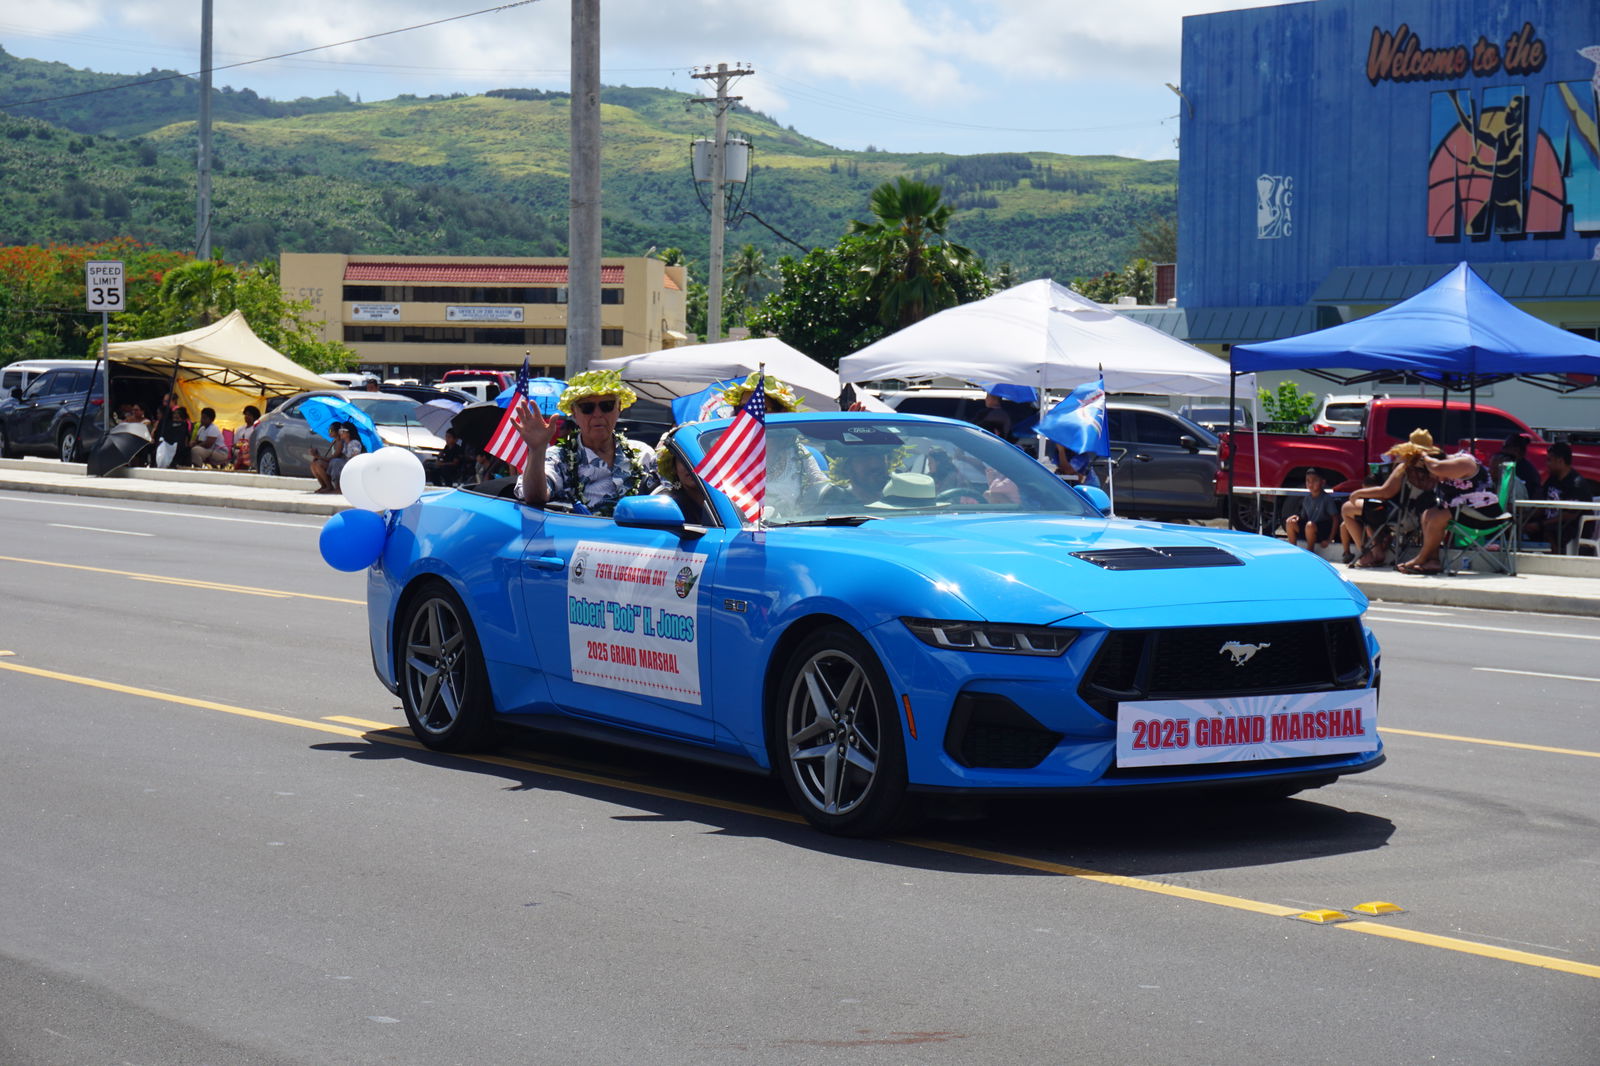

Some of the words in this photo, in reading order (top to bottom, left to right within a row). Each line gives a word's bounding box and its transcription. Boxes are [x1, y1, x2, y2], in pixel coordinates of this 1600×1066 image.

[1367, 23, 1469, 87] Welcome
[1472, 35, 1500, 78] to
[1504, 21, 1546, 75] the
[89, 267, 121, 275] SPEED
[93, 277, 117, 285] LIMIT
[92, 287, 120, 305] 35
[613, 565, 653, 585] LIBERATION
[653, 569, 667, 586] DAY
[569, 596, 605, 628] Robert
[643, 606, 656, 637] H.
[657, 609, 694, 642] Jones
[587, 640, 609, 661] 2025
[610, 644, 637, 667] GRAND
[638, 649, 679, 674] MARSHAL
[1131, 718, 1190, 750] 2025
[1195, 714, 1266, 748] GRAND
[1270, 707, 1366, 743] MARSHAL
